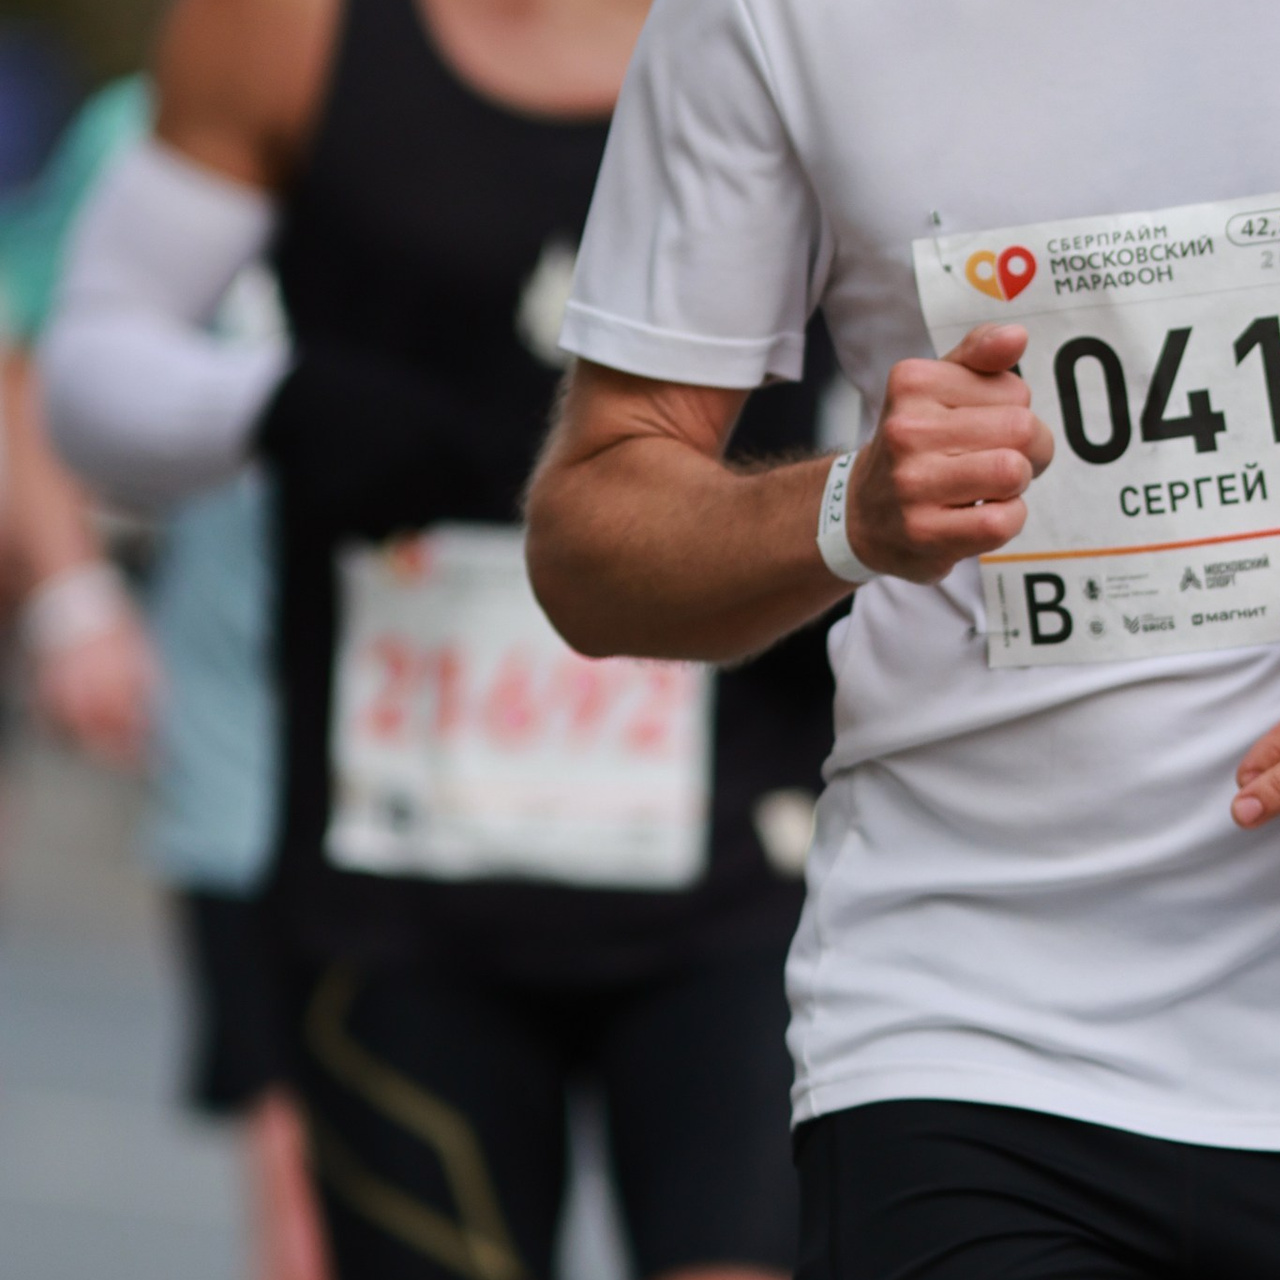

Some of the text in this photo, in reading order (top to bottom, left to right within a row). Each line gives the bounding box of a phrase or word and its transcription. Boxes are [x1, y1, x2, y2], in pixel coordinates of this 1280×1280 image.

[1047, 224, 1168, 253] СБЕРПРАЙМ
[1050, 235, 1214, 274] МОСКОВСКИЙ
[1055, 264, 1174, 295] МАРАФОН
[1119, 462, 1268, 517] СЕРГЕЙ
